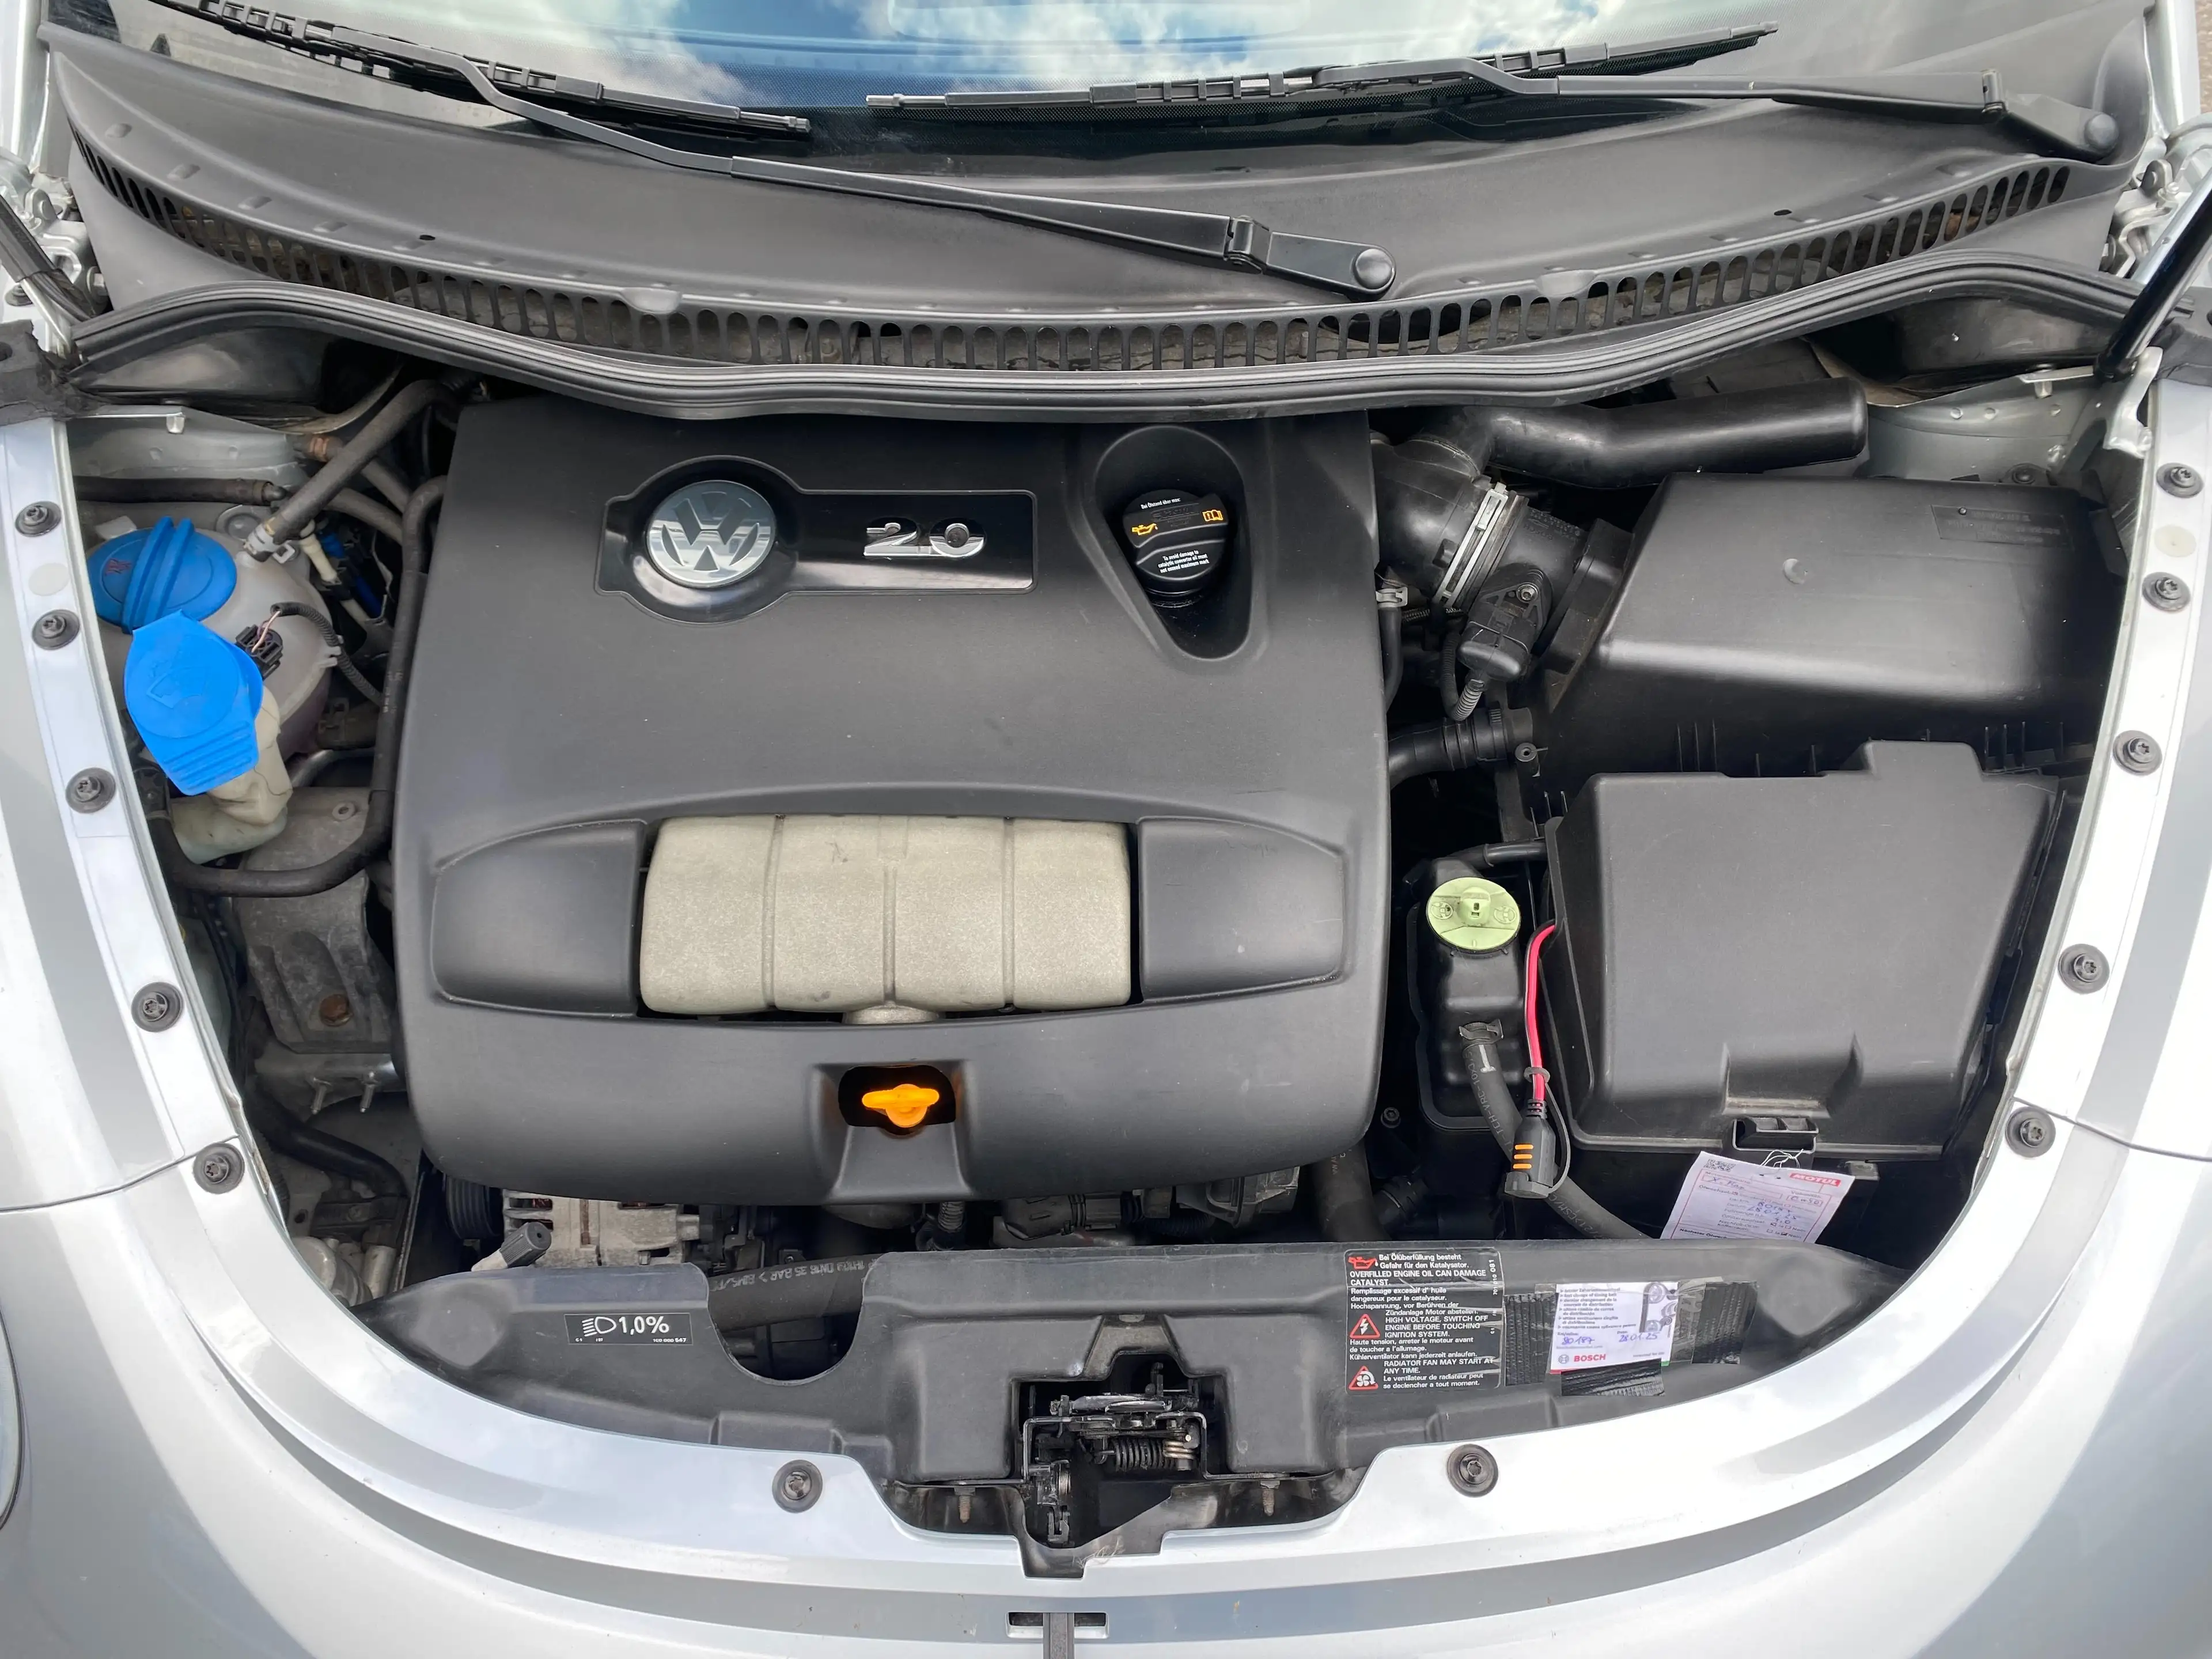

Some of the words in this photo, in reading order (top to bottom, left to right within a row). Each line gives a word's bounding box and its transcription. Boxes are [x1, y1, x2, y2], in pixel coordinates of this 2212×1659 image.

[863, 519, 986, 558] 2.0
[1793, 1173, 1838, 1185] MOTUL
[1391, 1253, 1435, 1262] Ölüberfüllung
[770, 1267, 793, 1281] BAR
[795, 1266, 806, 1277] 35
[1385, 1309, 1423, 1317] Zündanlage
[619, 1316, 669, 1335] 1,0%
[1574, 1354, 1606, 1362] BOSCH
